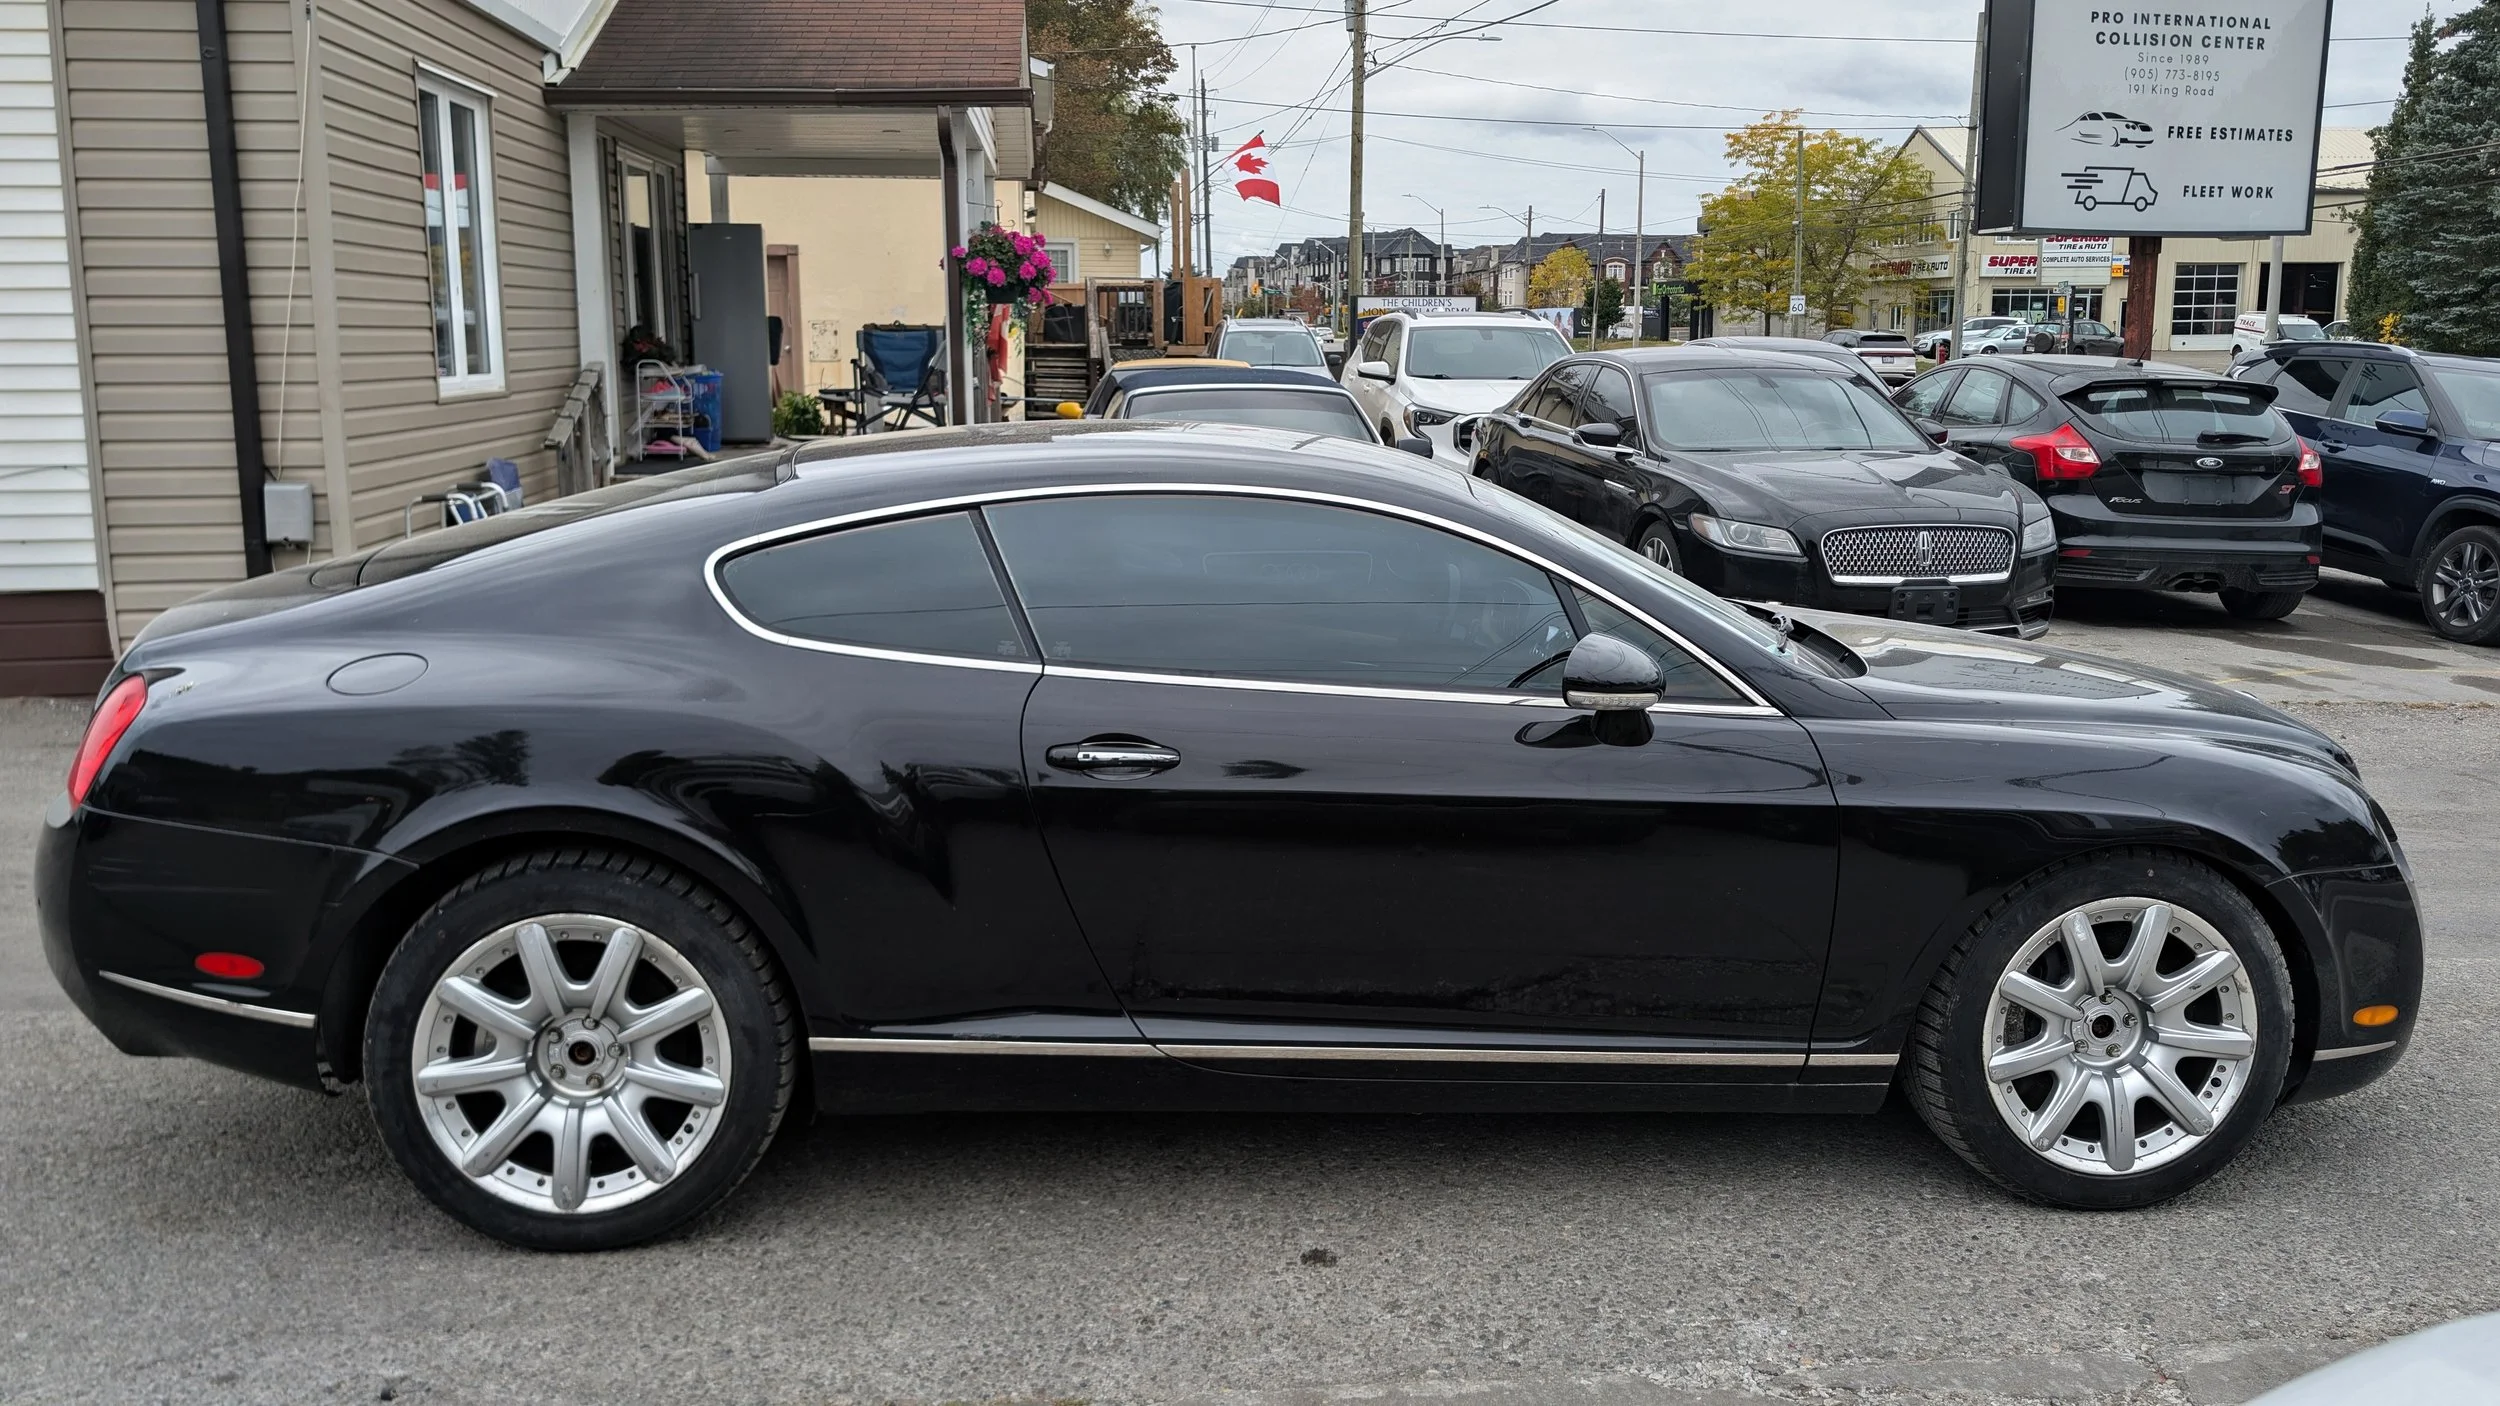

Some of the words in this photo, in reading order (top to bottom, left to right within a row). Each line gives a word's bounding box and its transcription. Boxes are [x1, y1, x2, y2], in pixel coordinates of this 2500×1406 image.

[2090, 11, 2124, 24] PRO
[2133, 12, 2271, 30] INTERNATIONAL
[2095, 31, 2193, 48] COLLISION
[2201, 35, 2266, 50] CENTER
[2137, 51, 2174, 64] Since
[2180, 54, 2210, 65] 1989
[2124, 66, 2159, 82] (905)
[2165, 69, 2221, 82] 773-8195
[2128, 84, 2146, 95] 191
[2151, 84, 2179, 98] King
[2185, 85, 2215, 97] Road
[2167, 125, 2203, 139] FREE
[2210, 127, 2294, 142] ESTIMATES
[2183, 185, 2225, 198] FLEET
[2231, 185, 2275, 199] WORK
[2042, 256, 2070, 264] COMPLETE
[2085, 255, 2111, 263] SERVICES
[2003, 267, 2025, 275] TIRE
[1381, 298, 1399, 307] THE
[1401, 298, 1453, 308] CHILDREN'S
[1791, 303, 1804, 312] 60
[2279, 484, 2296, 495] ST
